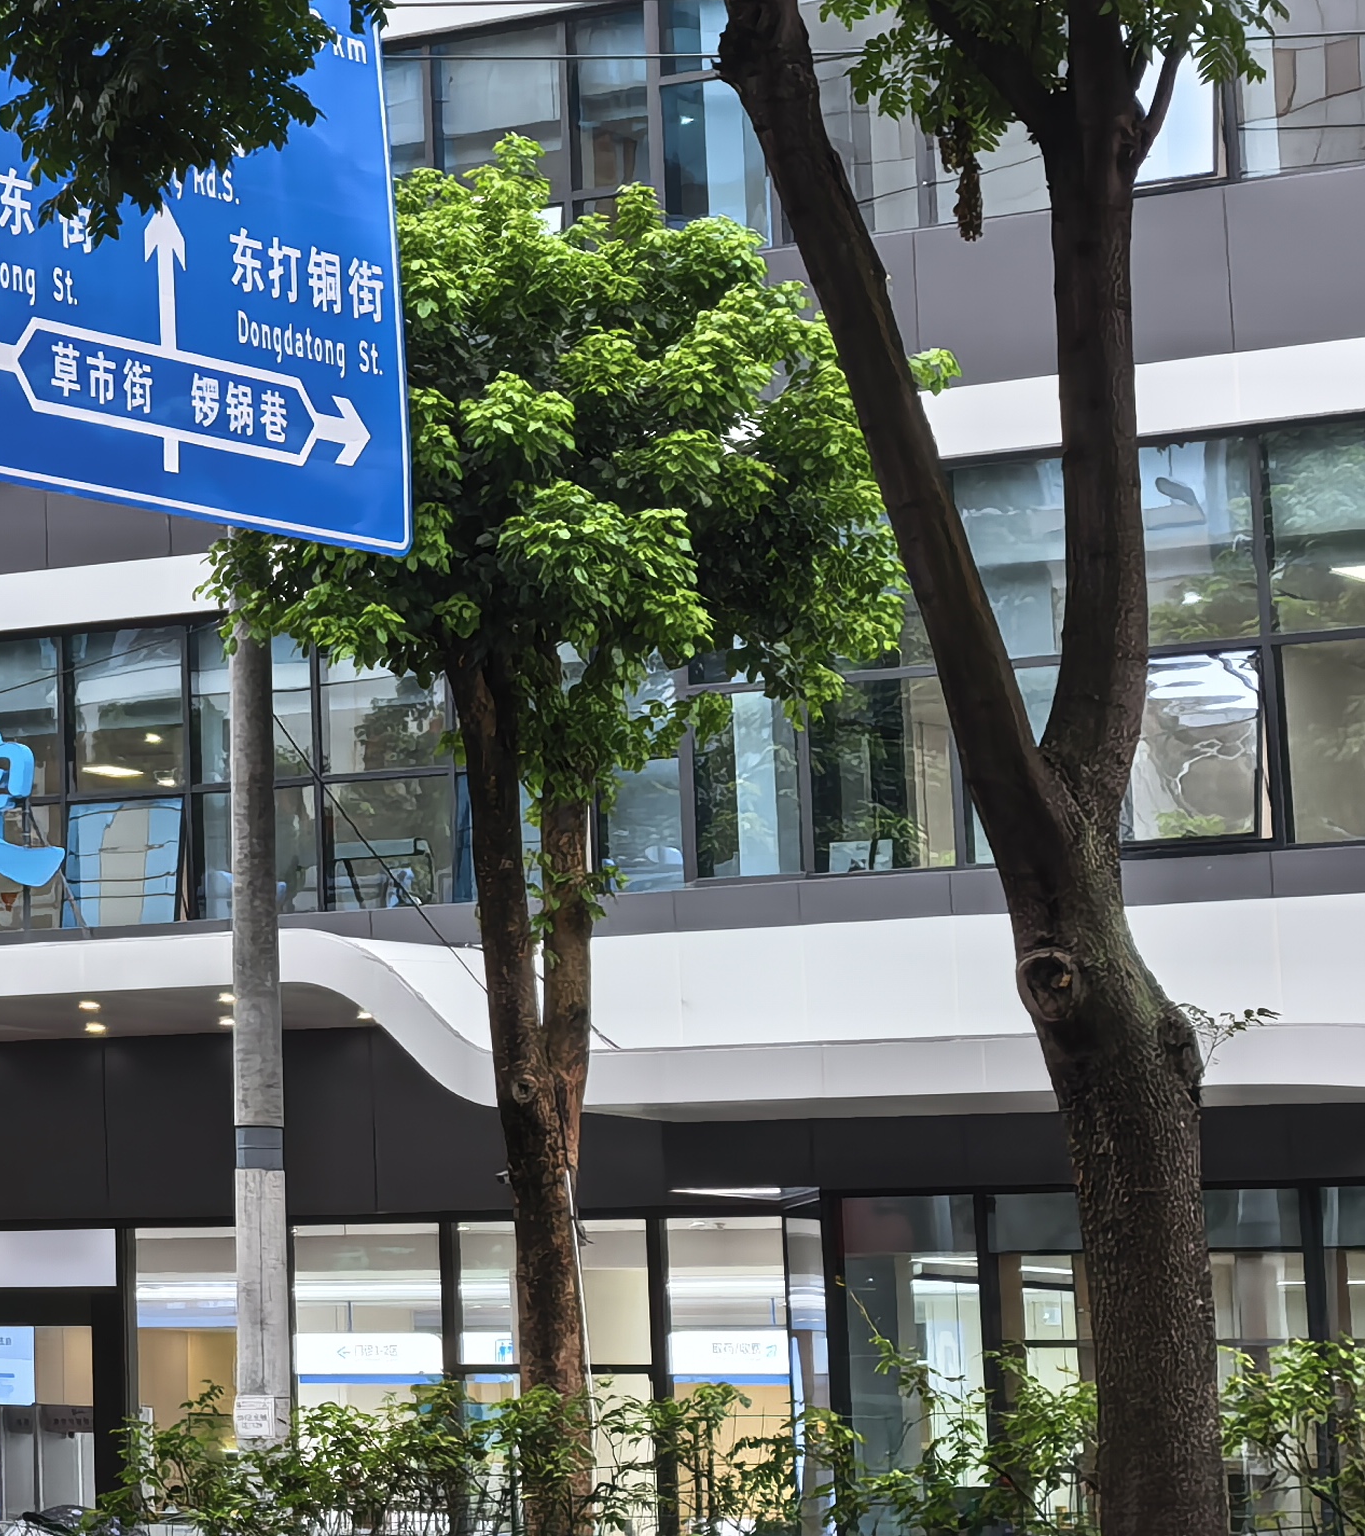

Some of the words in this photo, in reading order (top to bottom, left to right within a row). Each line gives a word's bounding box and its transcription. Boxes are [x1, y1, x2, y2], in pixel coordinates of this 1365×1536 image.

[53, 269, 79, 306] St.
[229, 227, 384, 323] 东打铜街
[236, 310, 346, 378] Dongdatong
[358, 340, 384, 375] St.
[50, 341, 153, 415] 草市街
[190, 372, 288, 444] 锣锅巷
